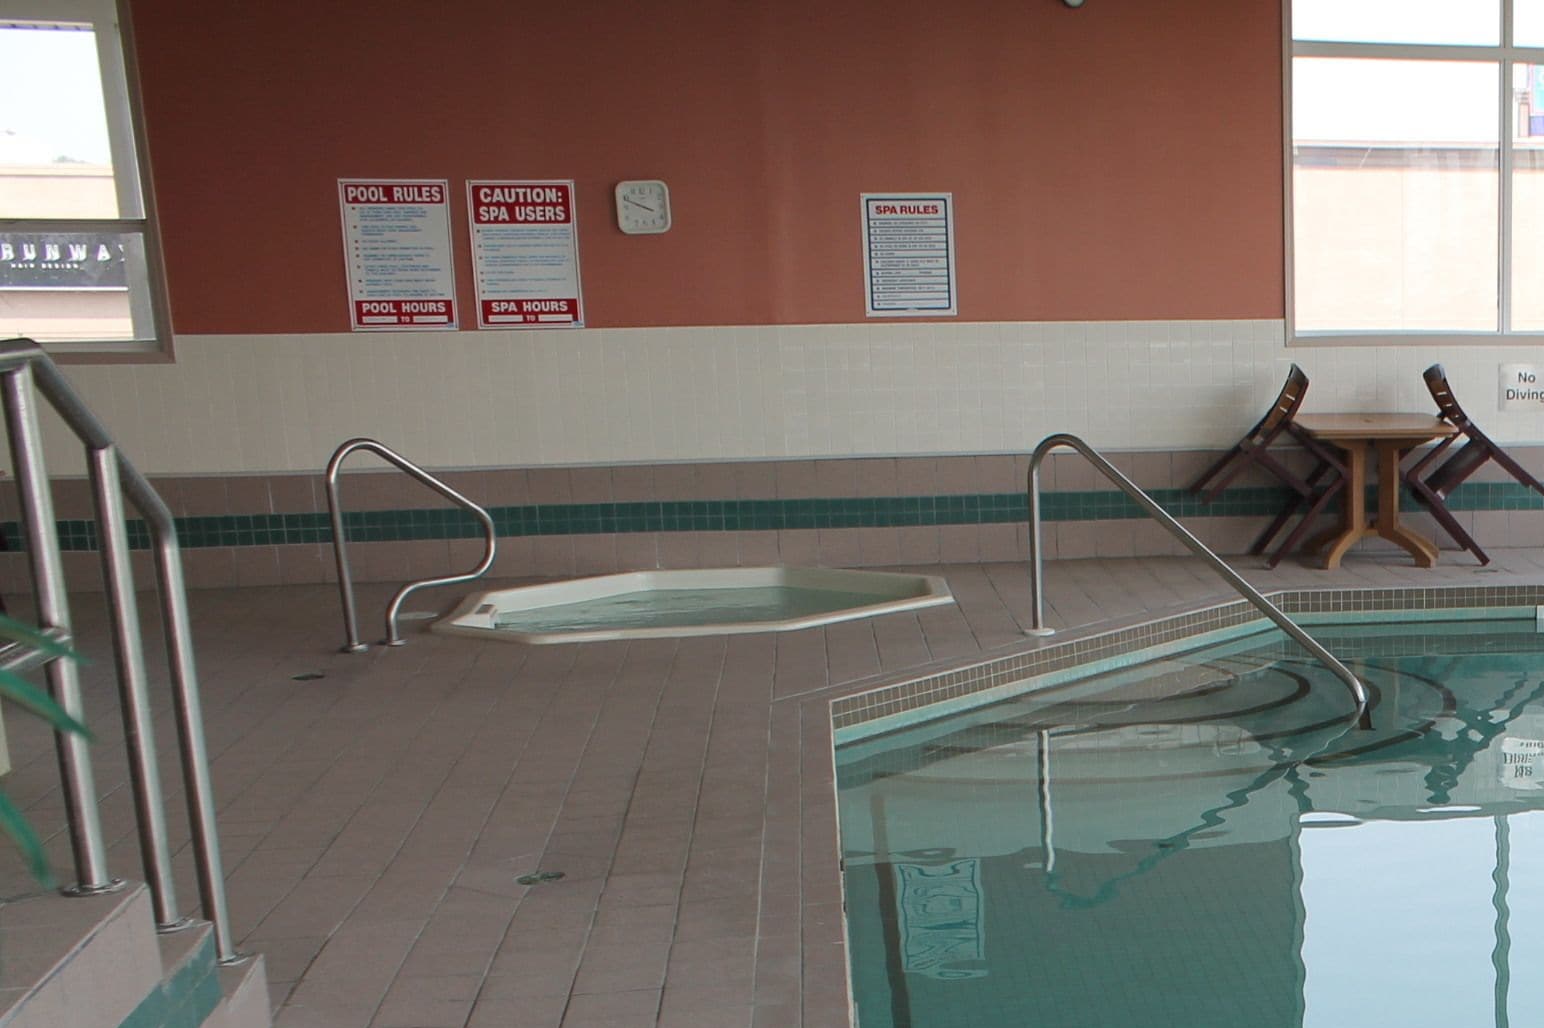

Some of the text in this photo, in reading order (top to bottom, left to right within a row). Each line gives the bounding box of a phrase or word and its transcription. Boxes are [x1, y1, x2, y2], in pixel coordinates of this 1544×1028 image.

[347, 186, 441, 202] POOL RULES
[479, 187, 563, 203] CAUTION:
[479, 206, 566, 221] SPA USERS
[875, 205, 939, 215] SPA RULES
[362, 302, 446, 313] POOL HOURS
[491, 301, 568, 313] SPA HOURS
[1518, 371, 1536, 383] No
